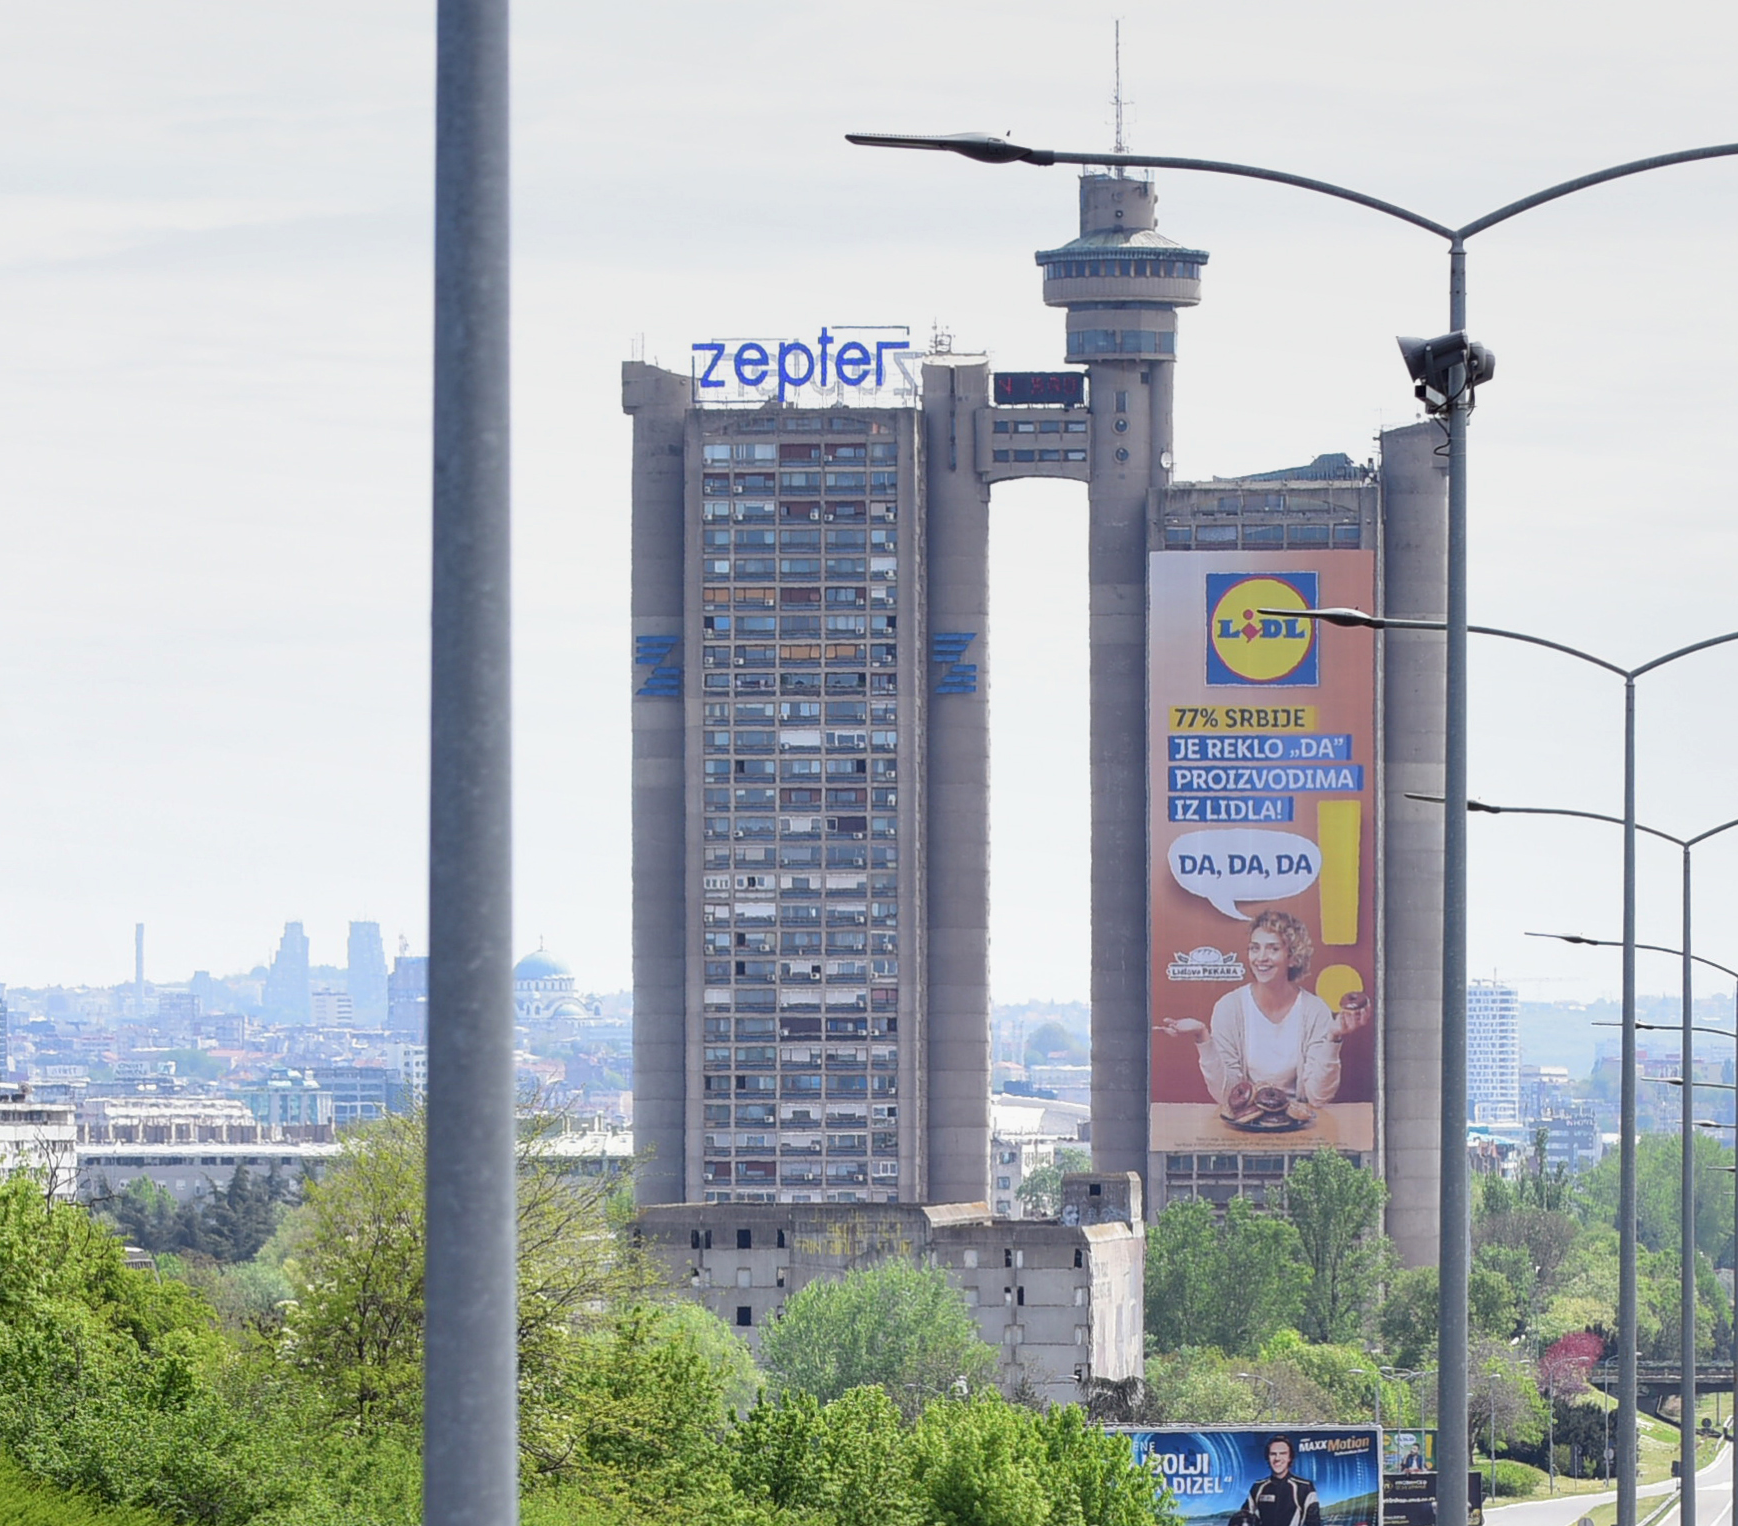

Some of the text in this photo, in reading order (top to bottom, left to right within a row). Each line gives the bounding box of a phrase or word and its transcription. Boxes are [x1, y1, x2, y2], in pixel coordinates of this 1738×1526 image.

[692, 327, 910, 402] zepter
[1174, 708, 1306, 728] 77% SRBIJE
[1174, 738, 1201, 759] JE
[1206, 738, 1284, 759] REKLO
[1175, 768, 1355, 789] PROIZVODIMA
[1175, 799, 1282, 820] IZ LIDLA!
[1179, 854, 1313, 879] DA, DA, DA
[1202, 967, 1238, 976] PEKARA
